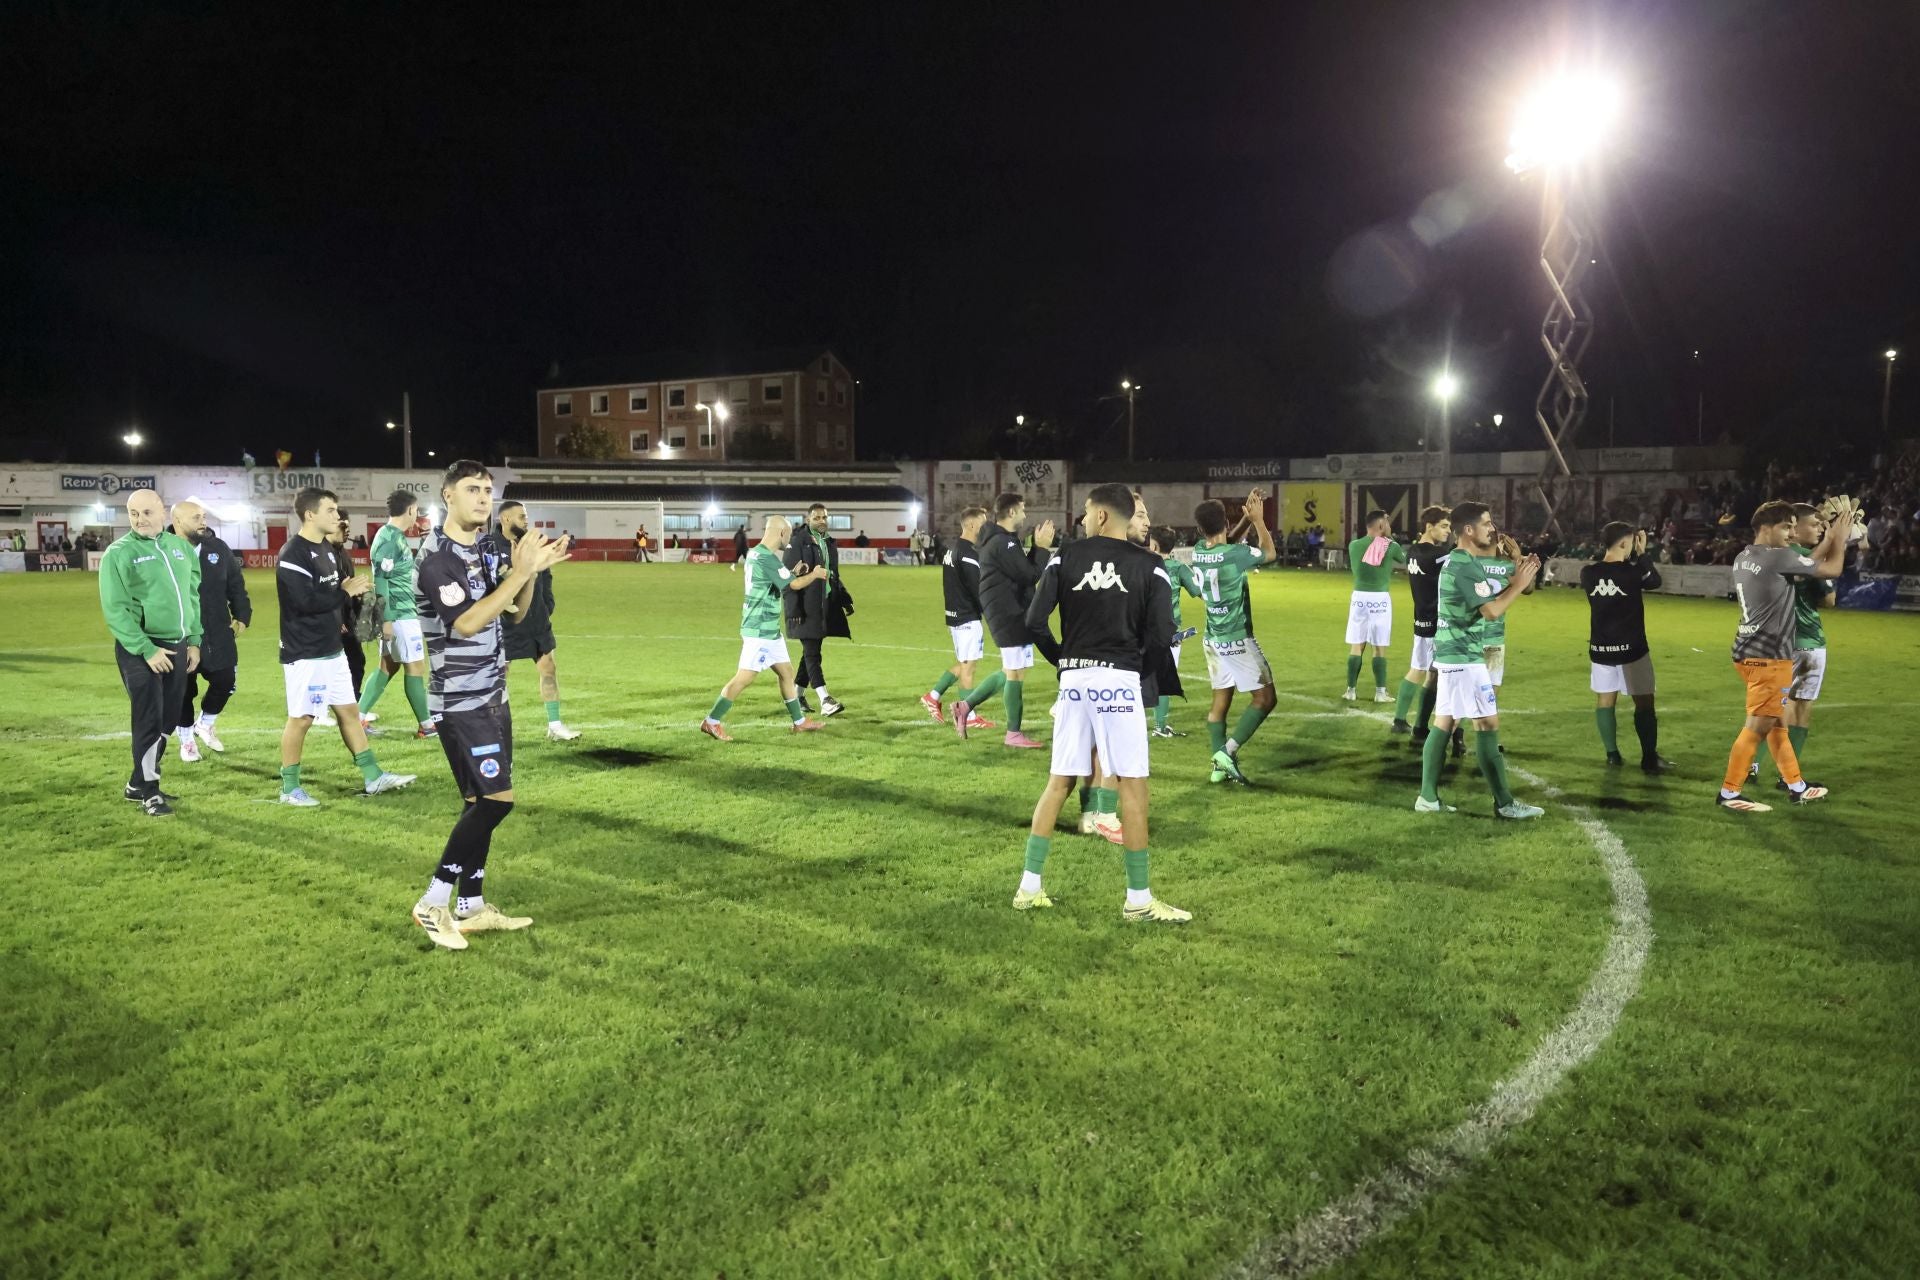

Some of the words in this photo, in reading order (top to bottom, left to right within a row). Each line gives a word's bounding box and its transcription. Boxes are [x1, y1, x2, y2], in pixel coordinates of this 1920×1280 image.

[1208, 461, 1281, 477] novakcafé
[63, 477, 97, 488] Reny
[121, 477, 154, 488] Picot
[277, 473, 324, 490] SOMO
[397, 481, 429, 494] ence
[262, 554, 280, 567] COP
[41, 564, 69, 572] SPORT
[1483, 565, 1507, 575] TERO
[1087, 688, 1135, 702] bora
[1096, 705, 1134, 714] autos
